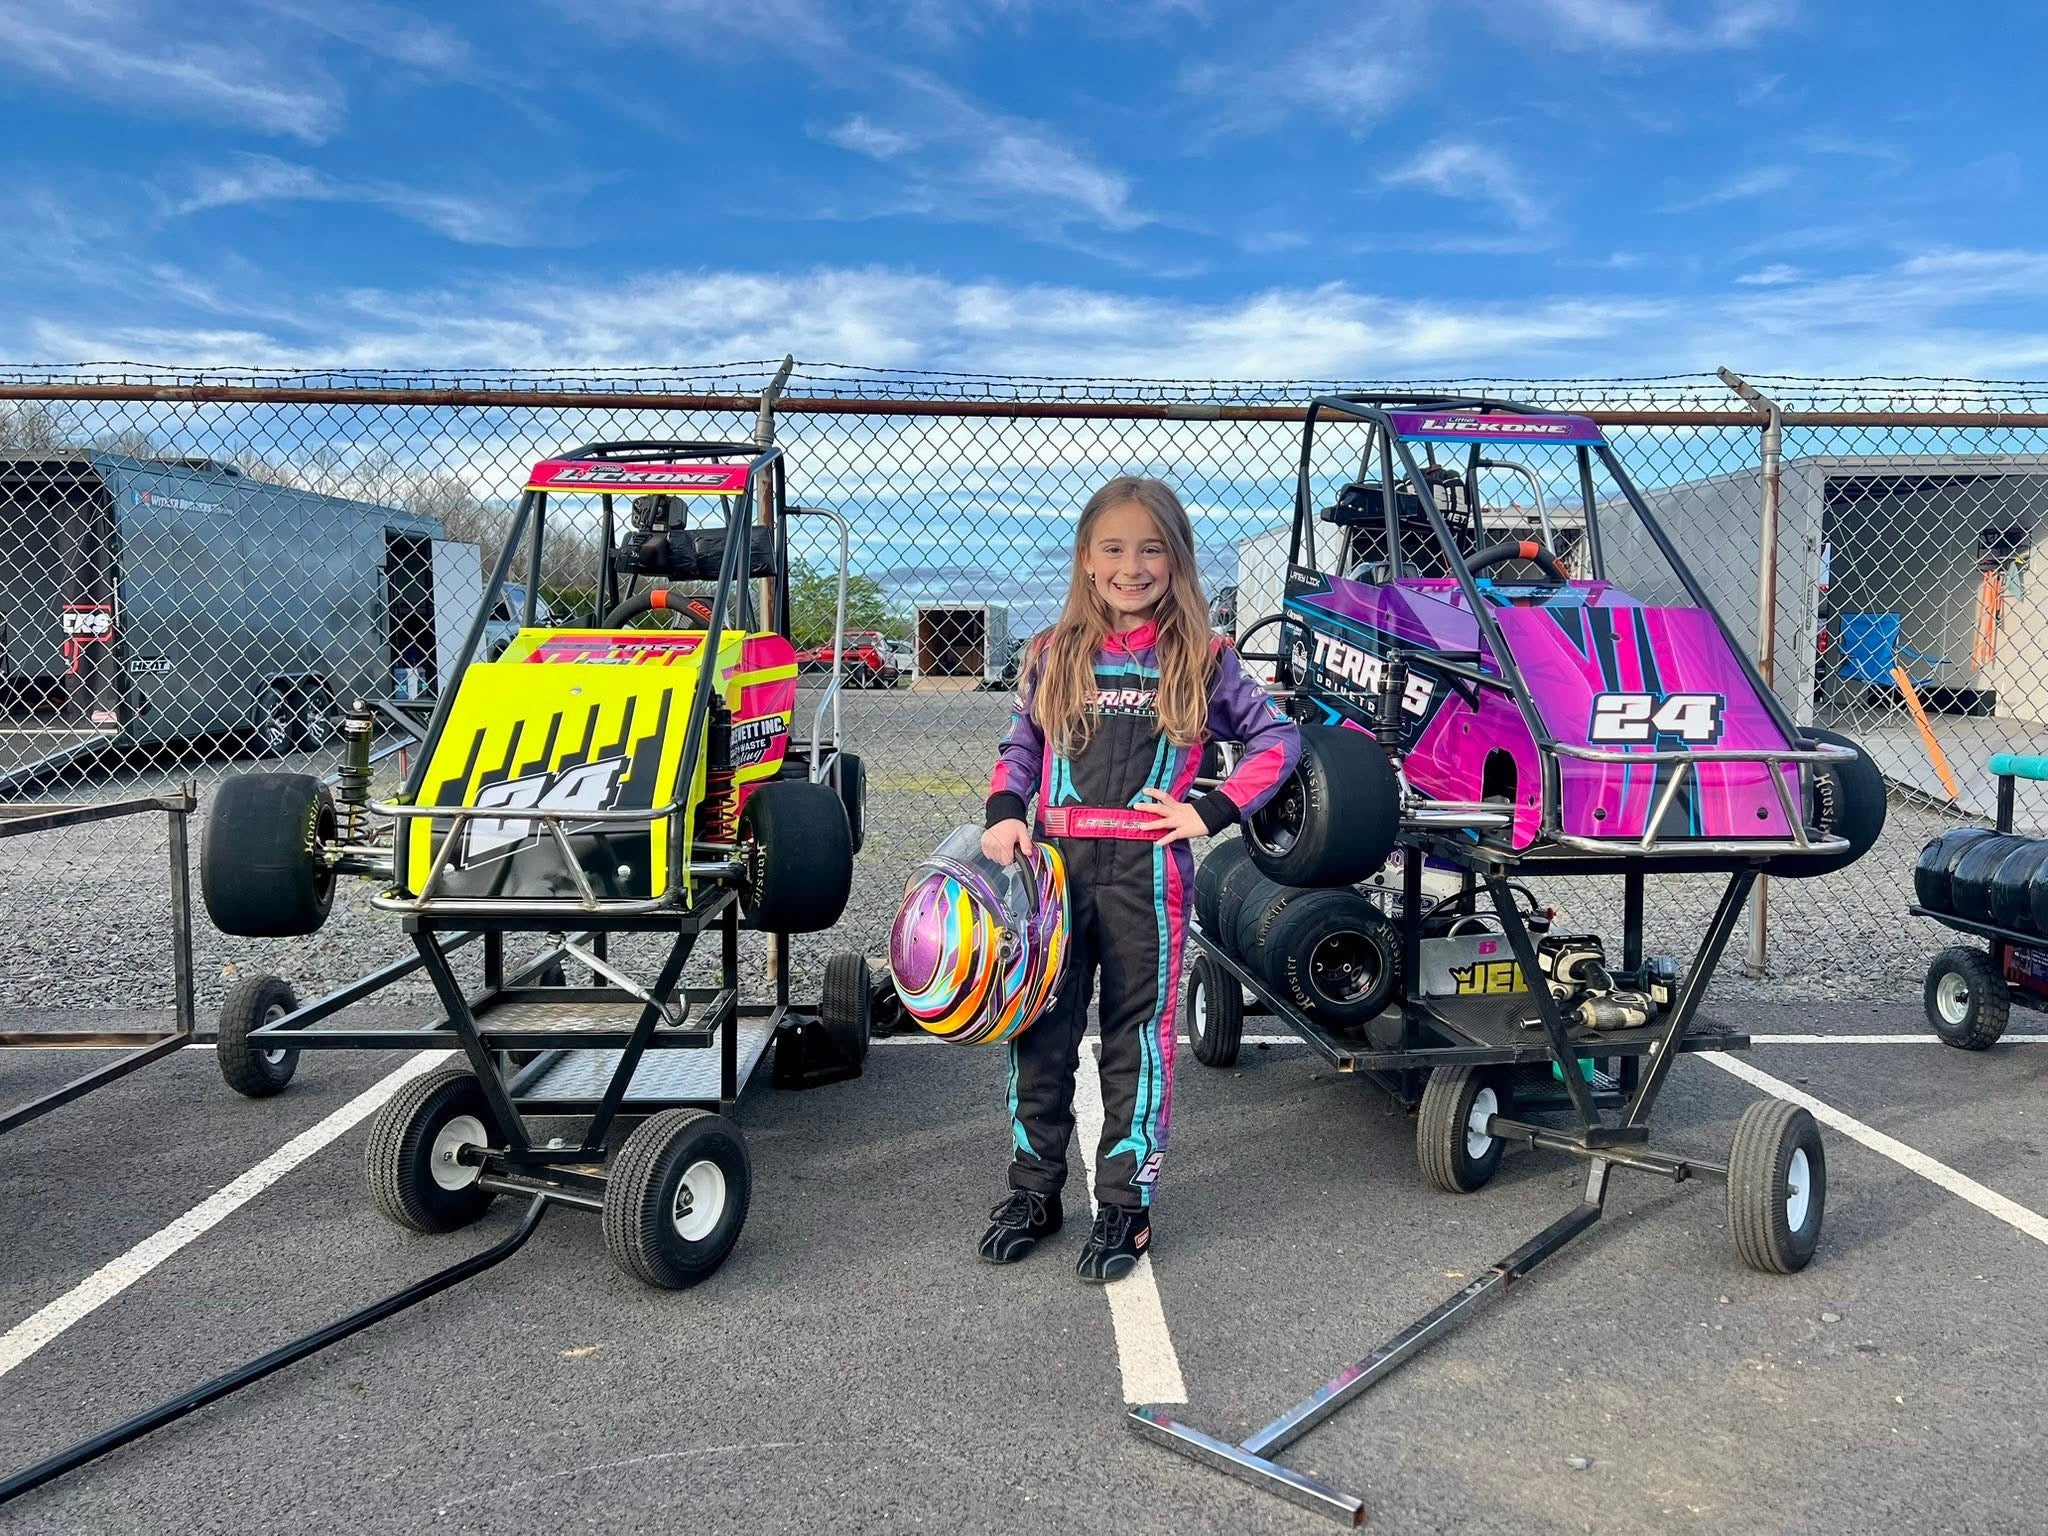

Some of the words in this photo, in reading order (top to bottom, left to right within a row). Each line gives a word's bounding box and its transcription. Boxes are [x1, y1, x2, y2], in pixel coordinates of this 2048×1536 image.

[1421, 419, 1569, 434] LICKONE
[552, 468, 727, 485] LICKONE
[1313, 630, 1434, 717] TERRS
[1316, 673, 1376, 713] DRIVETR
[761, 717, 785, 736] INC.
[1592, 694, 1717, 740] 24
[740, 739, 766, 752] WASTE
[464, 756, 628, 864] 24
